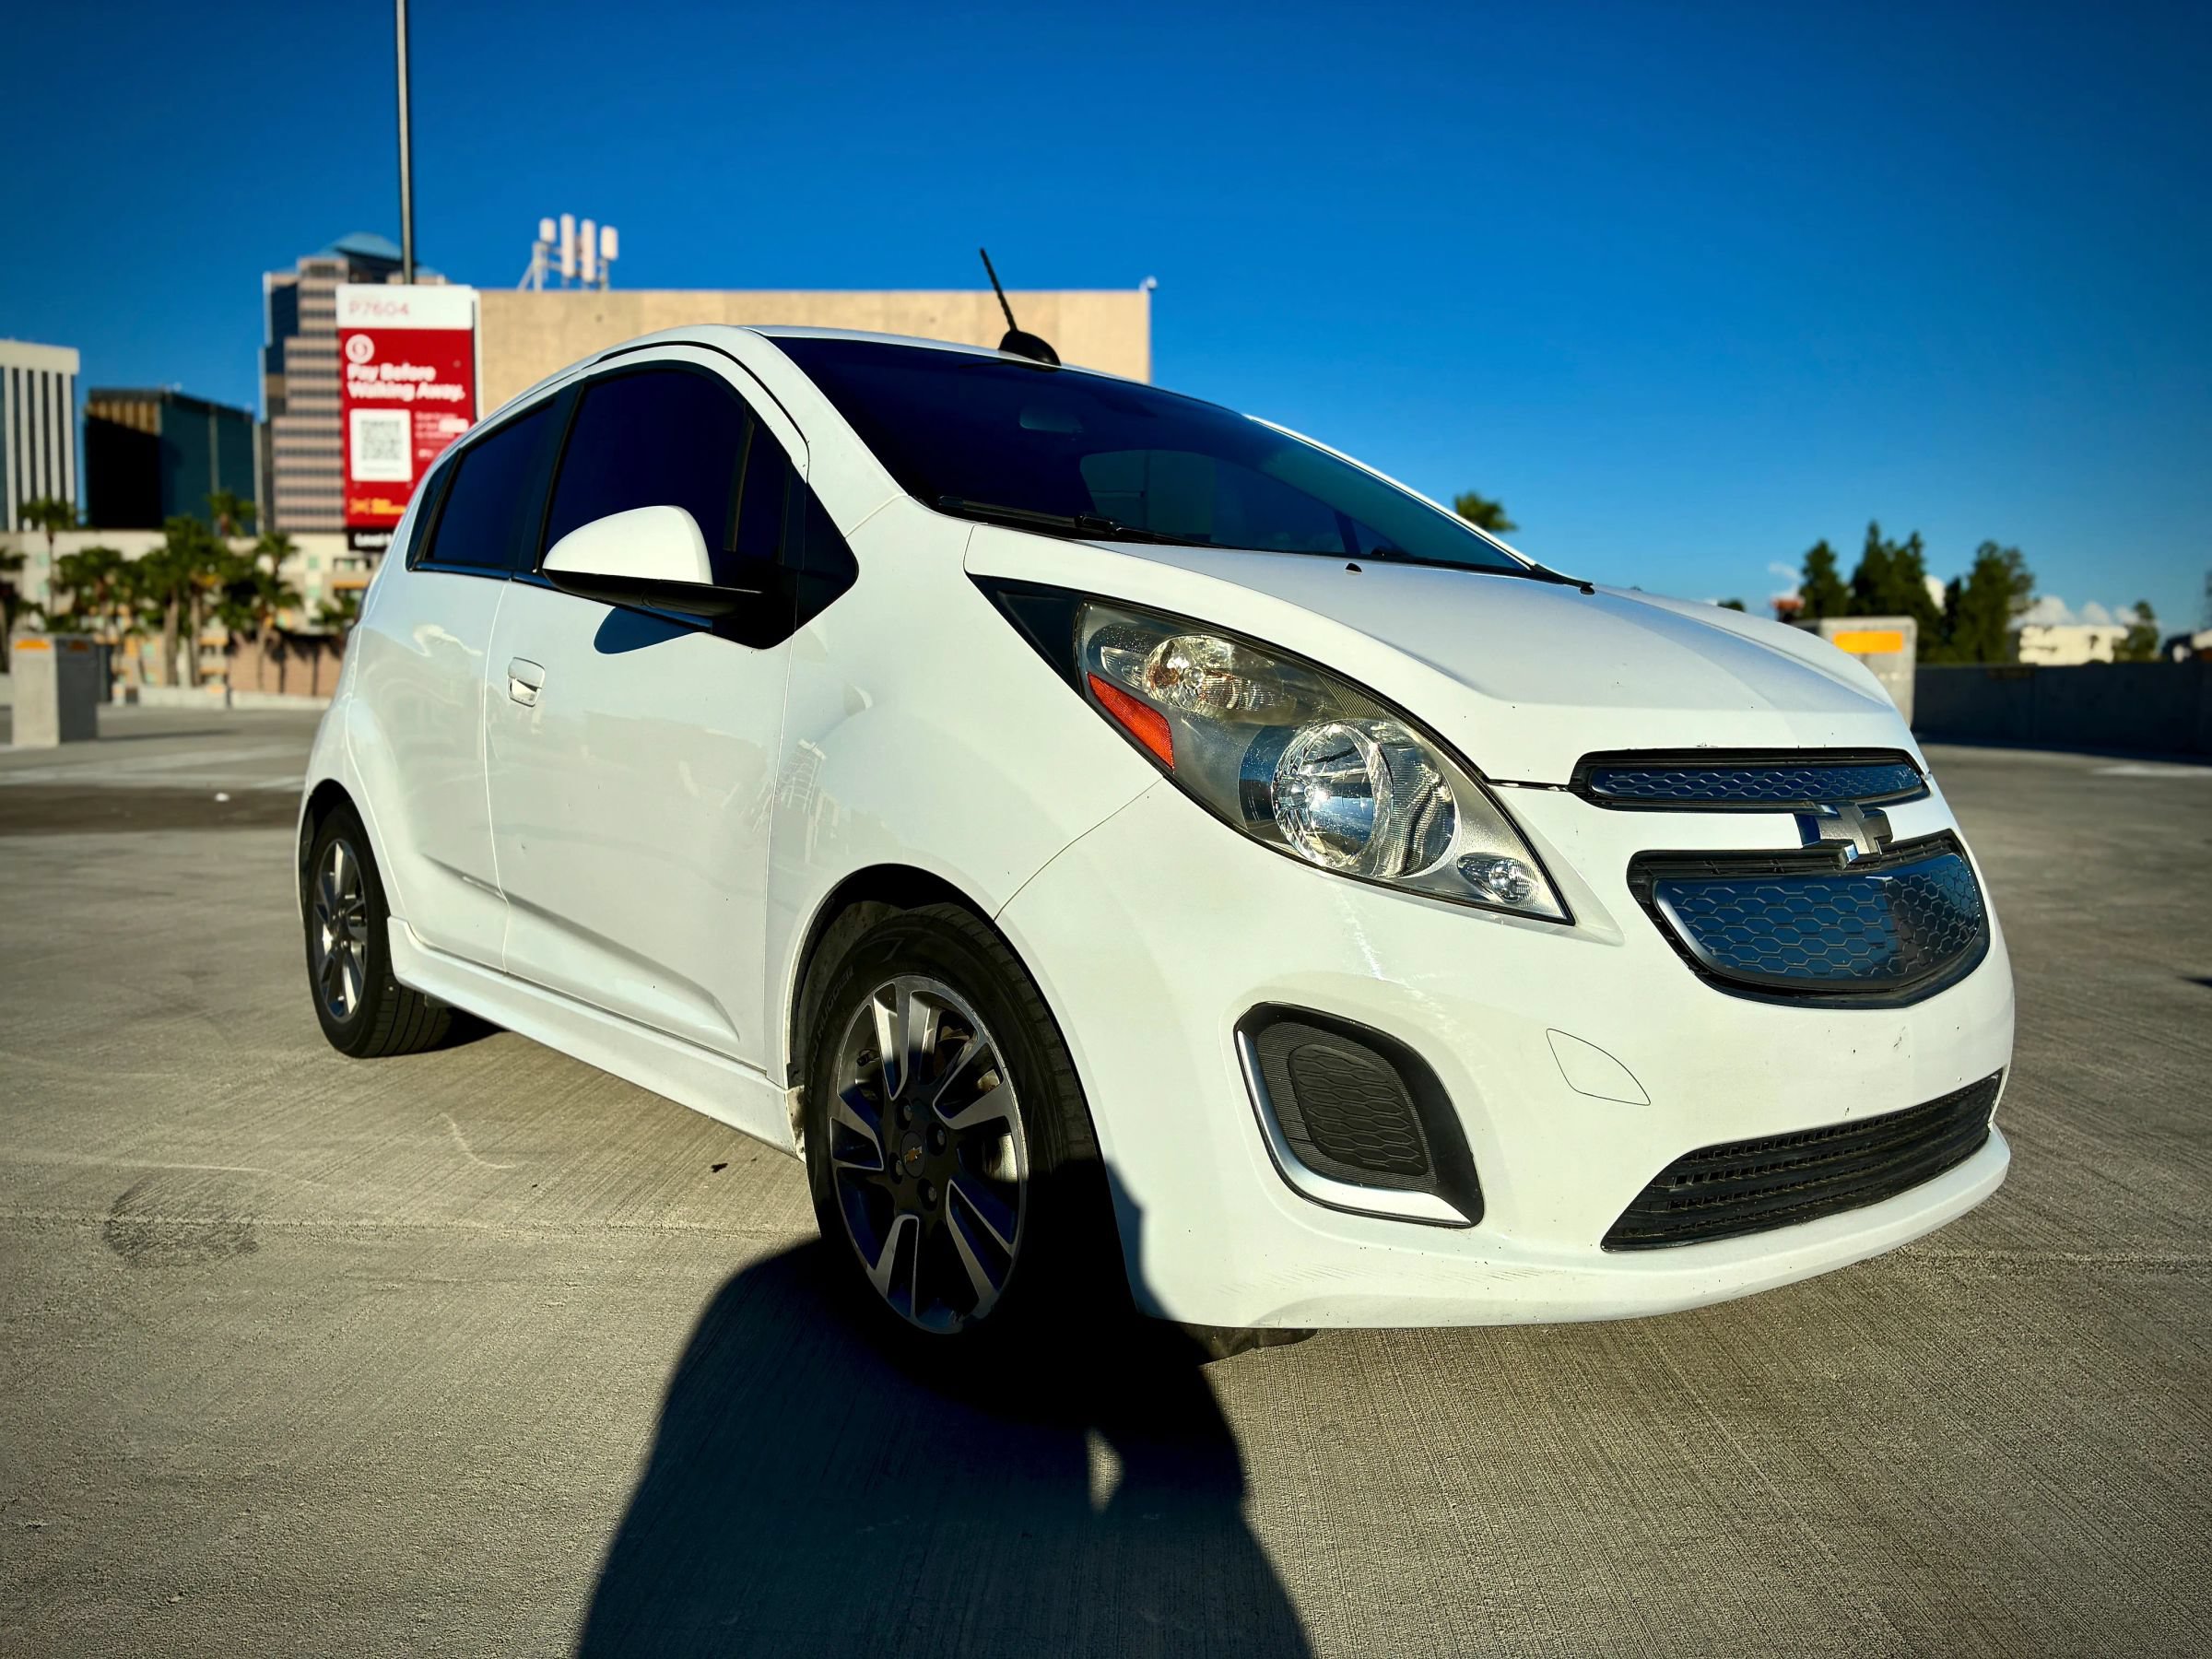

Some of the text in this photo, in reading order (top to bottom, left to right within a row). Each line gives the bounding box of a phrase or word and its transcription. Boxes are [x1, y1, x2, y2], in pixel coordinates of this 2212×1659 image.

[347, 362, 436, 382] Pay Before
[347, 382, 415, 402] Walking
